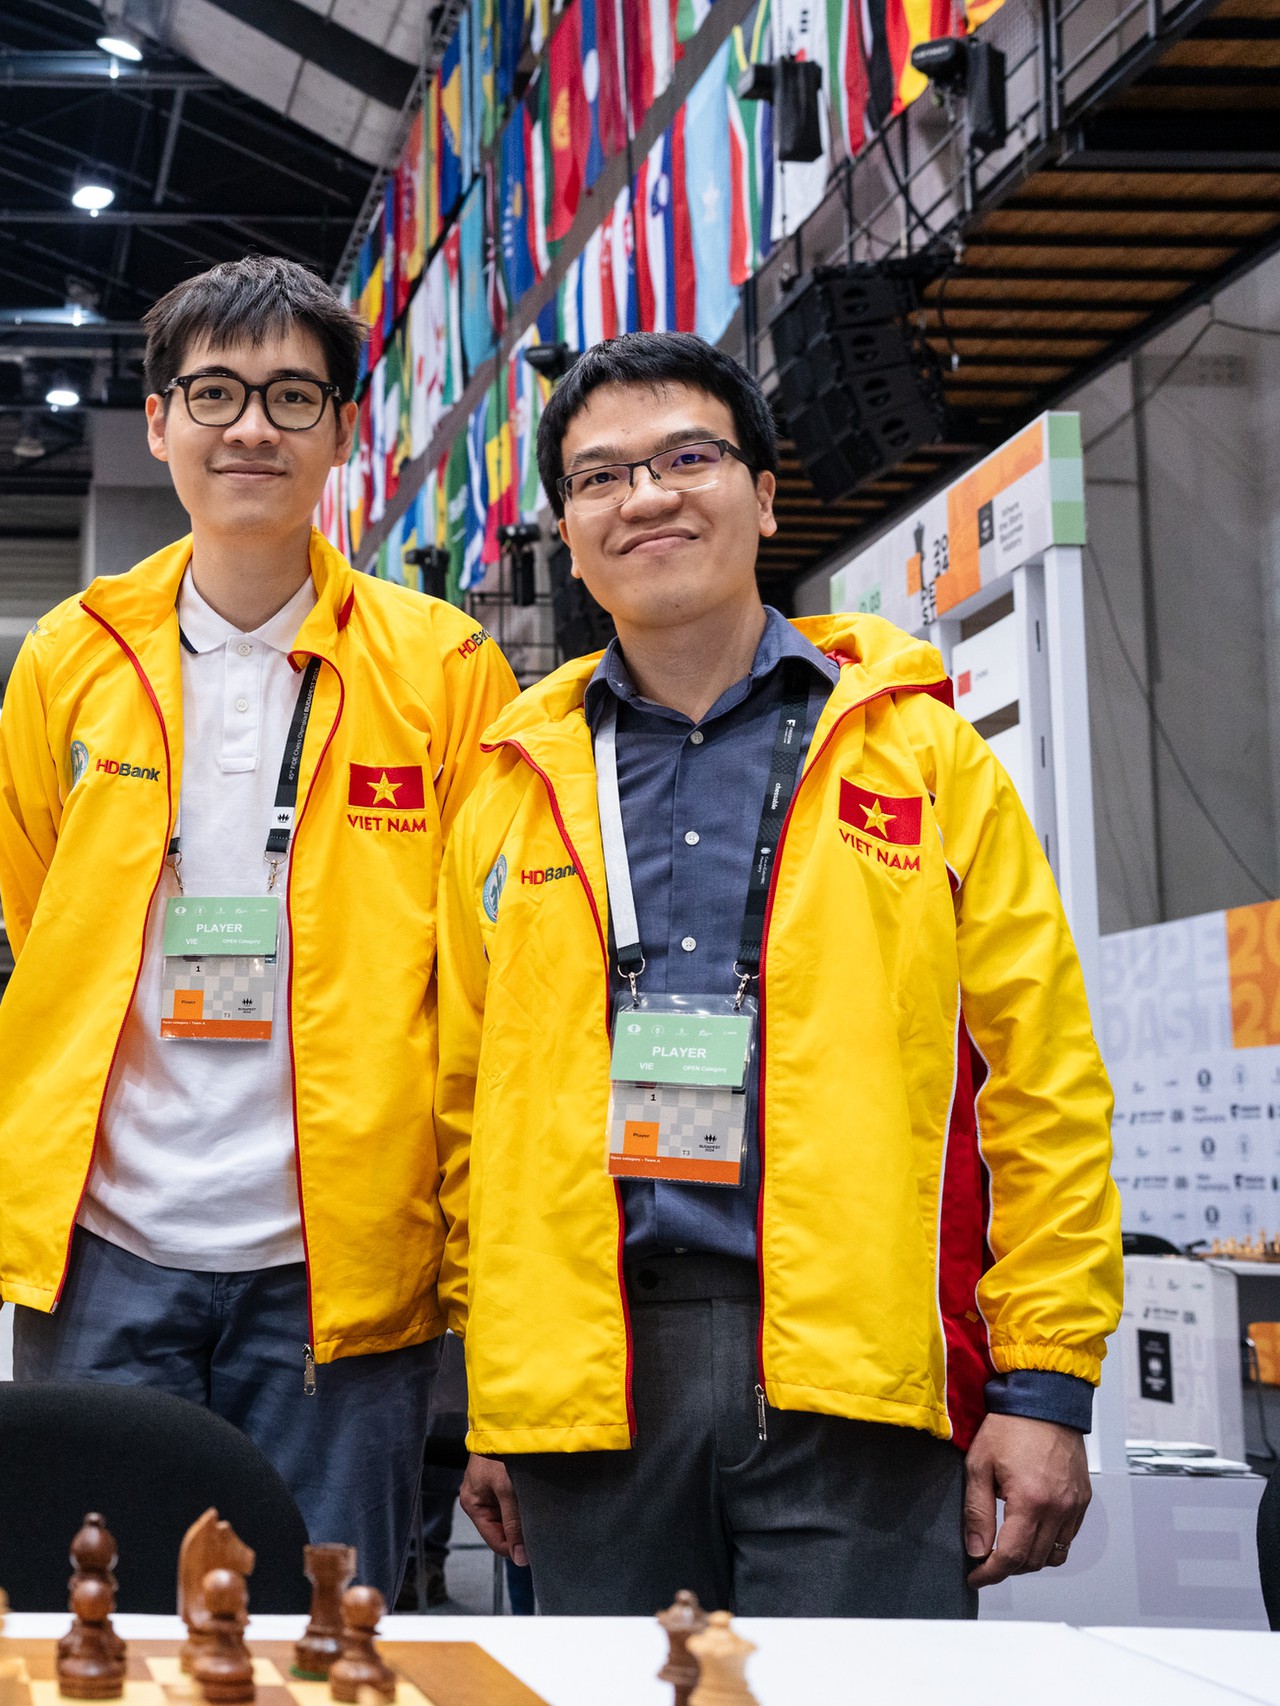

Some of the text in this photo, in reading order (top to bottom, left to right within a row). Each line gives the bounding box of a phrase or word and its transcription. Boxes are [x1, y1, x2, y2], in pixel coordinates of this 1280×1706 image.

[294, 739, 302, 756] Chess
[304, 682, 316, 712] BUDAPEST
[95, 758, 160, 782] HDBank
[347, 814, 426, 833] VIET NAM
[839, 828, 920, 872] VIET NAM
[196, 924, 242, 932] PLAYER
[652, 1046, 706, 1058] PLAYER
